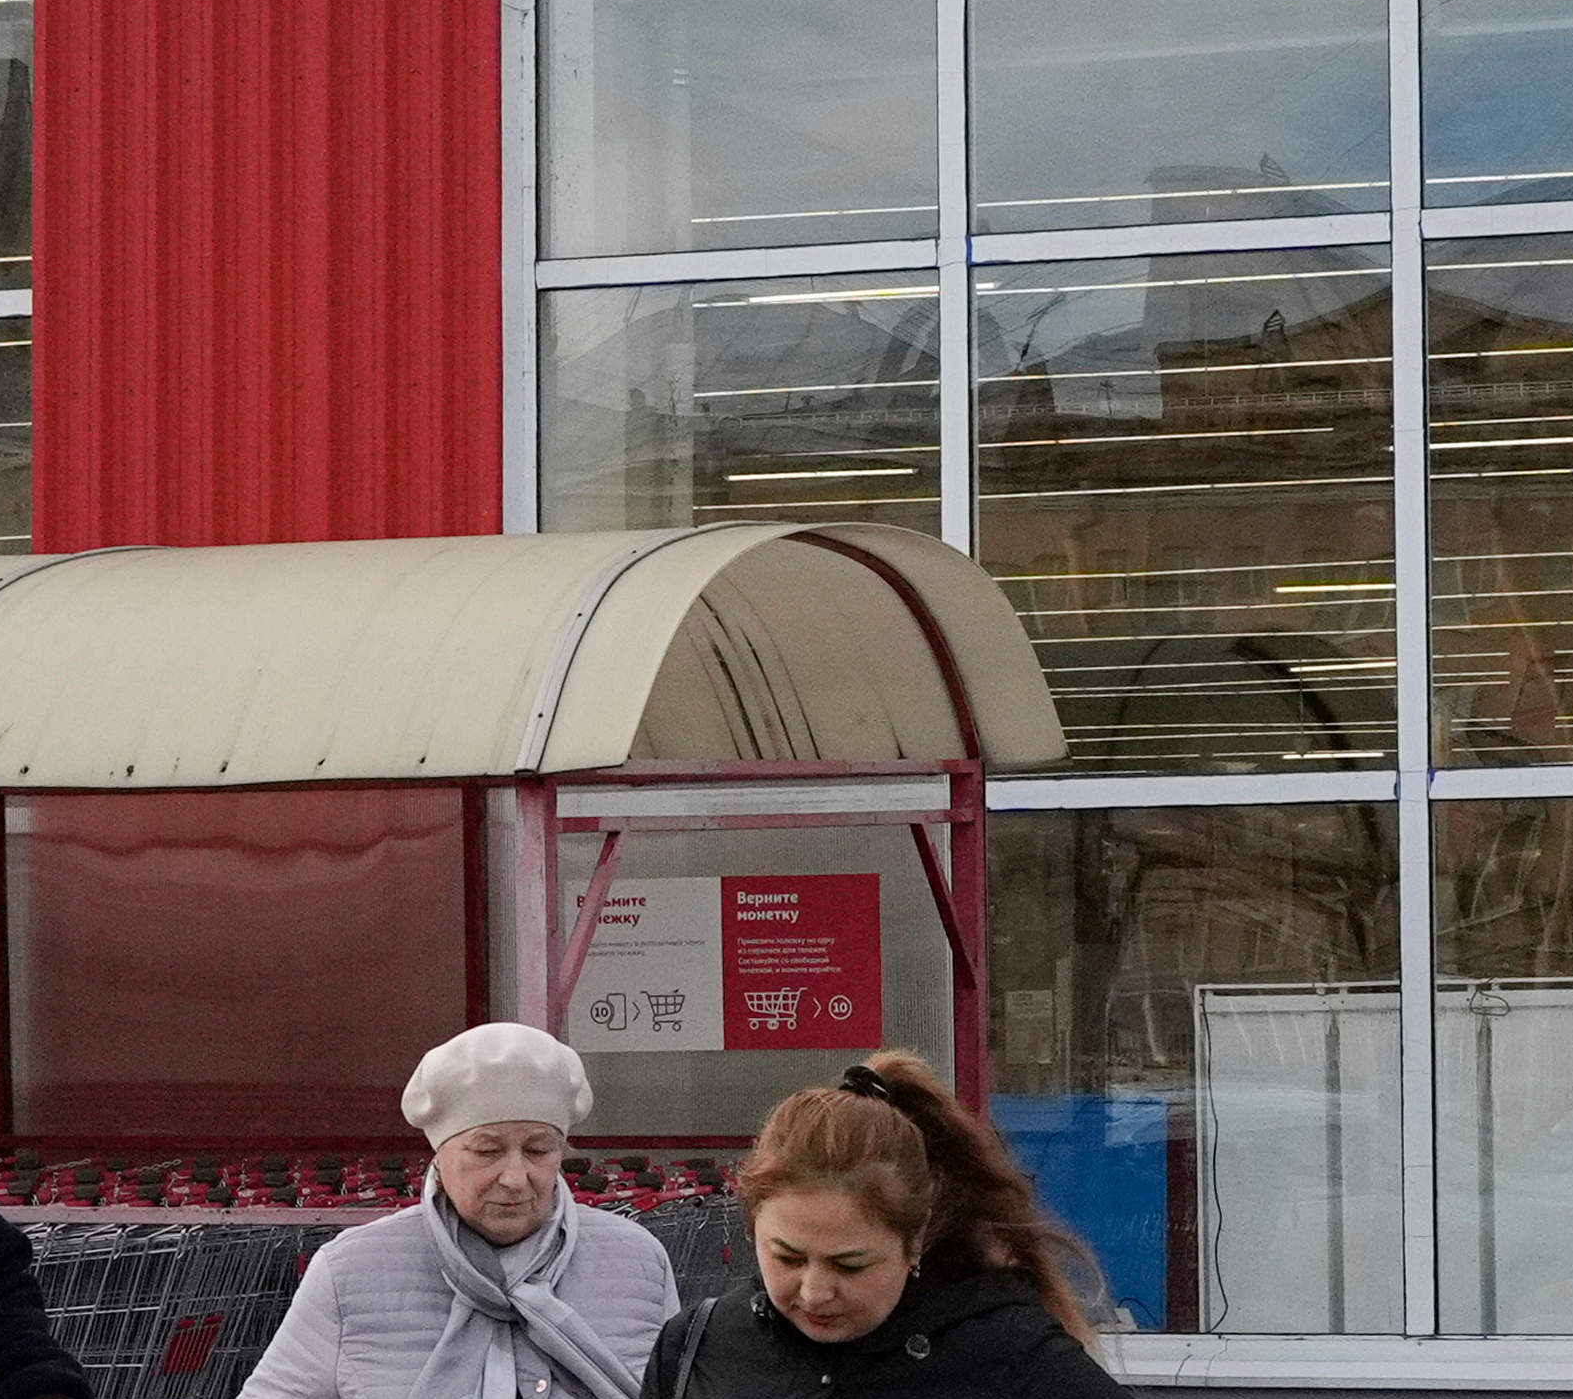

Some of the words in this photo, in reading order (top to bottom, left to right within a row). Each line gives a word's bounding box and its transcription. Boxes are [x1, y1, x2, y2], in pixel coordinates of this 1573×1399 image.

[576, 894, 647, 909] Вьмите
[736, 890, 799, 907] Верните
[594, 912, 641, 928] ежку
[736, 908, 800, 924] монетку
